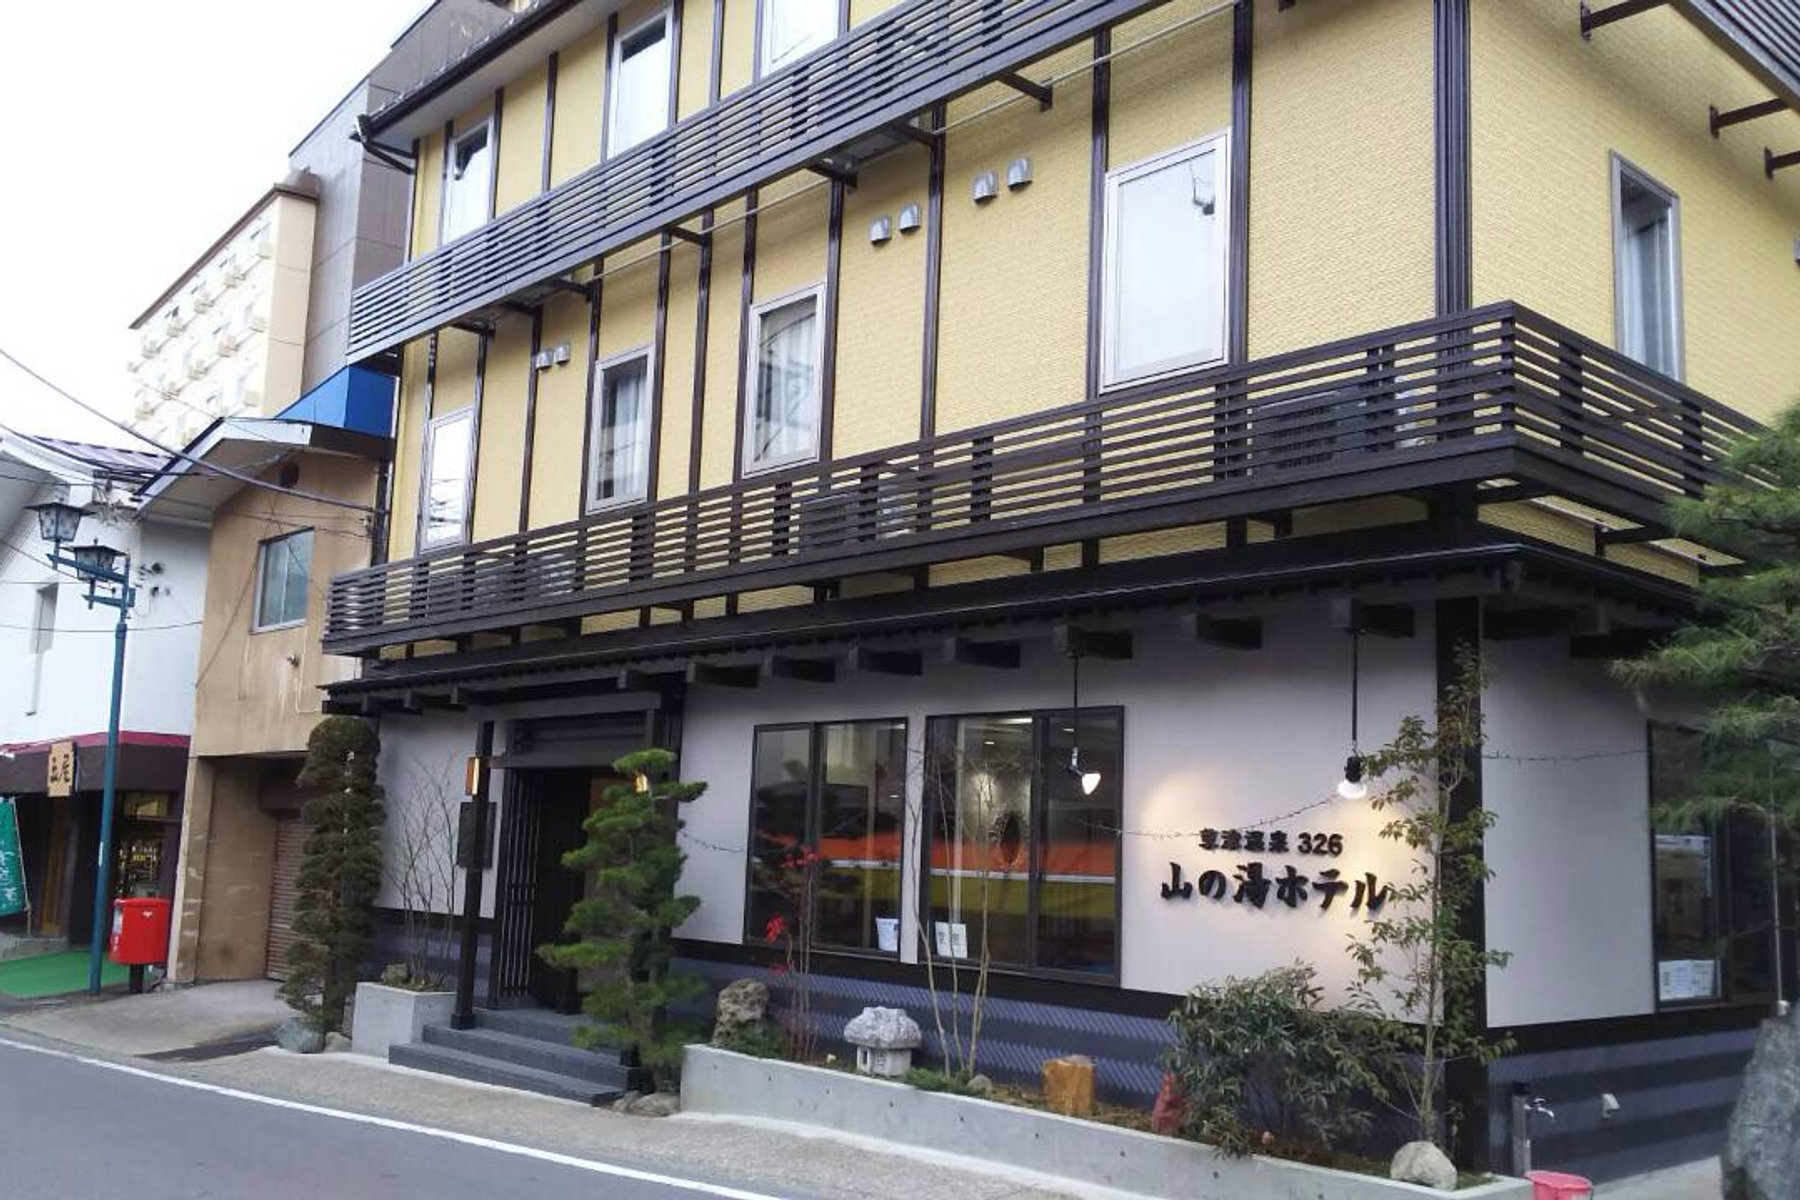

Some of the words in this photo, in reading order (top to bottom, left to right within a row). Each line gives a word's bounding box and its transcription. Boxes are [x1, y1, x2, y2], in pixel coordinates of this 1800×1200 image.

[1297, 832, 1343, 857] 326
[1160, 861, 1389, 911] 山の湯ホテル
